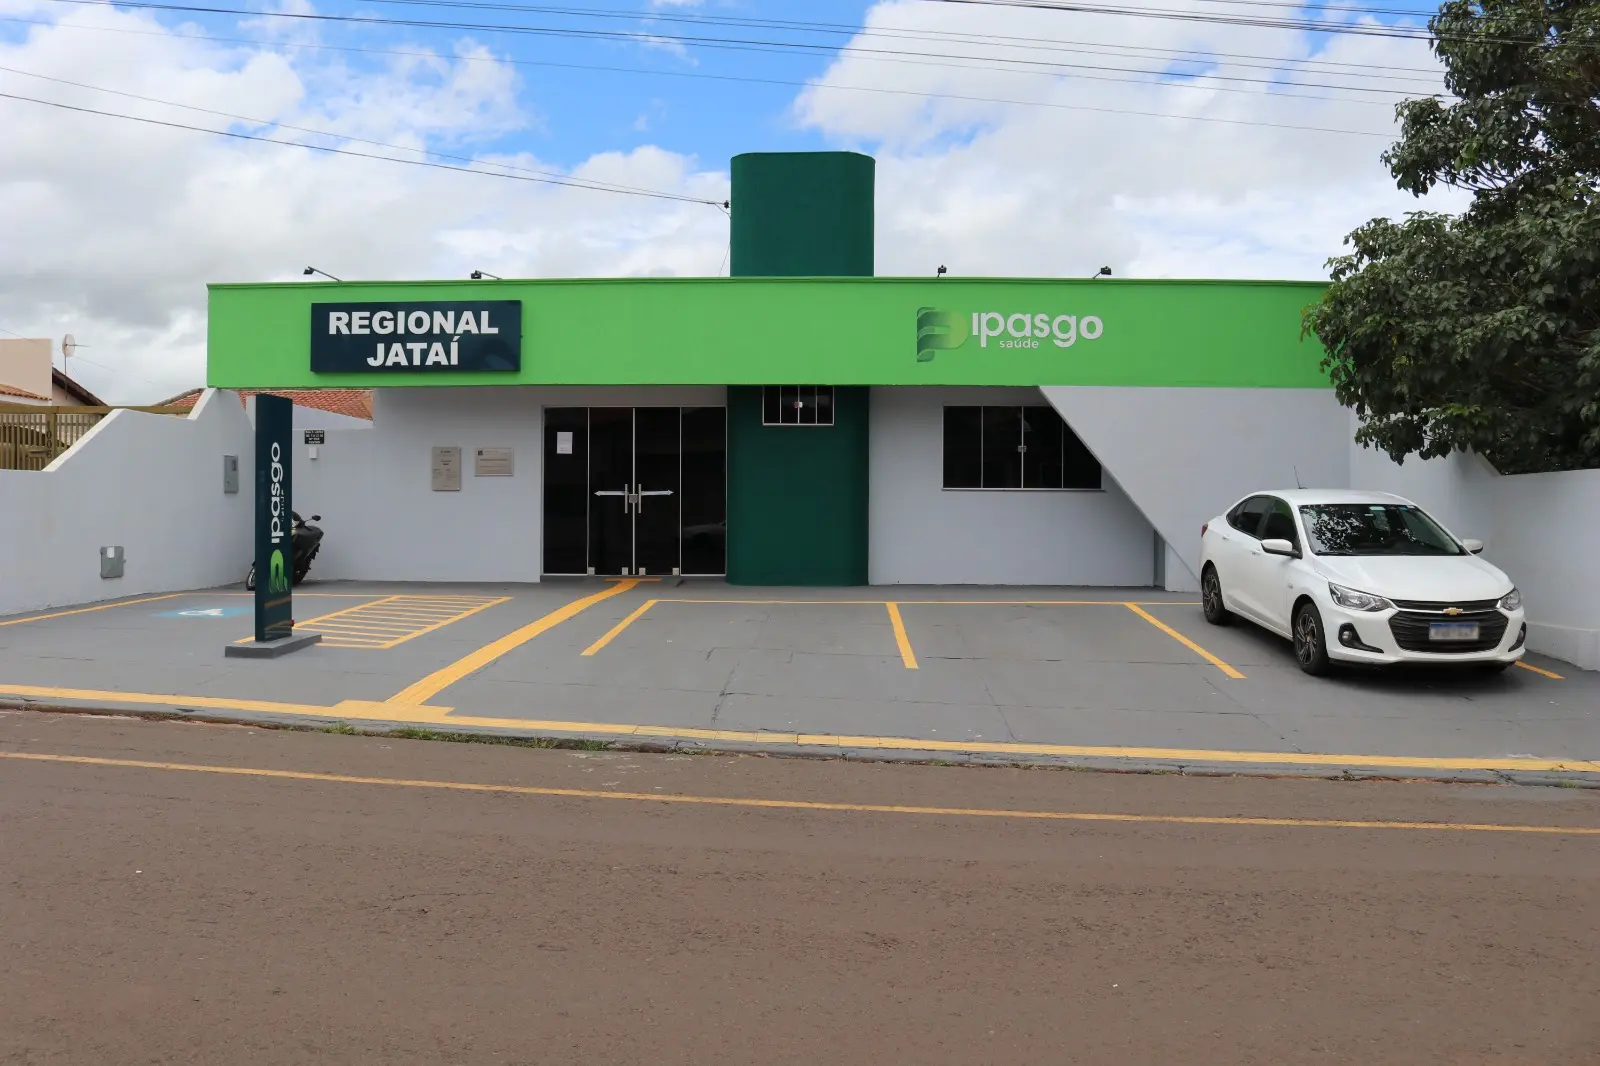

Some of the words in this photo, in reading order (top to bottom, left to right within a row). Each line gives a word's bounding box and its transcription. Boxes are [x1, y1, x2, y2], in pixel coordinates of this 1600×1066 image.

[328, 311, 499, 336] REGIONAL
[366, 336, 460, 367] JATAÍ
[999, 337, 1040, 349] saúde
